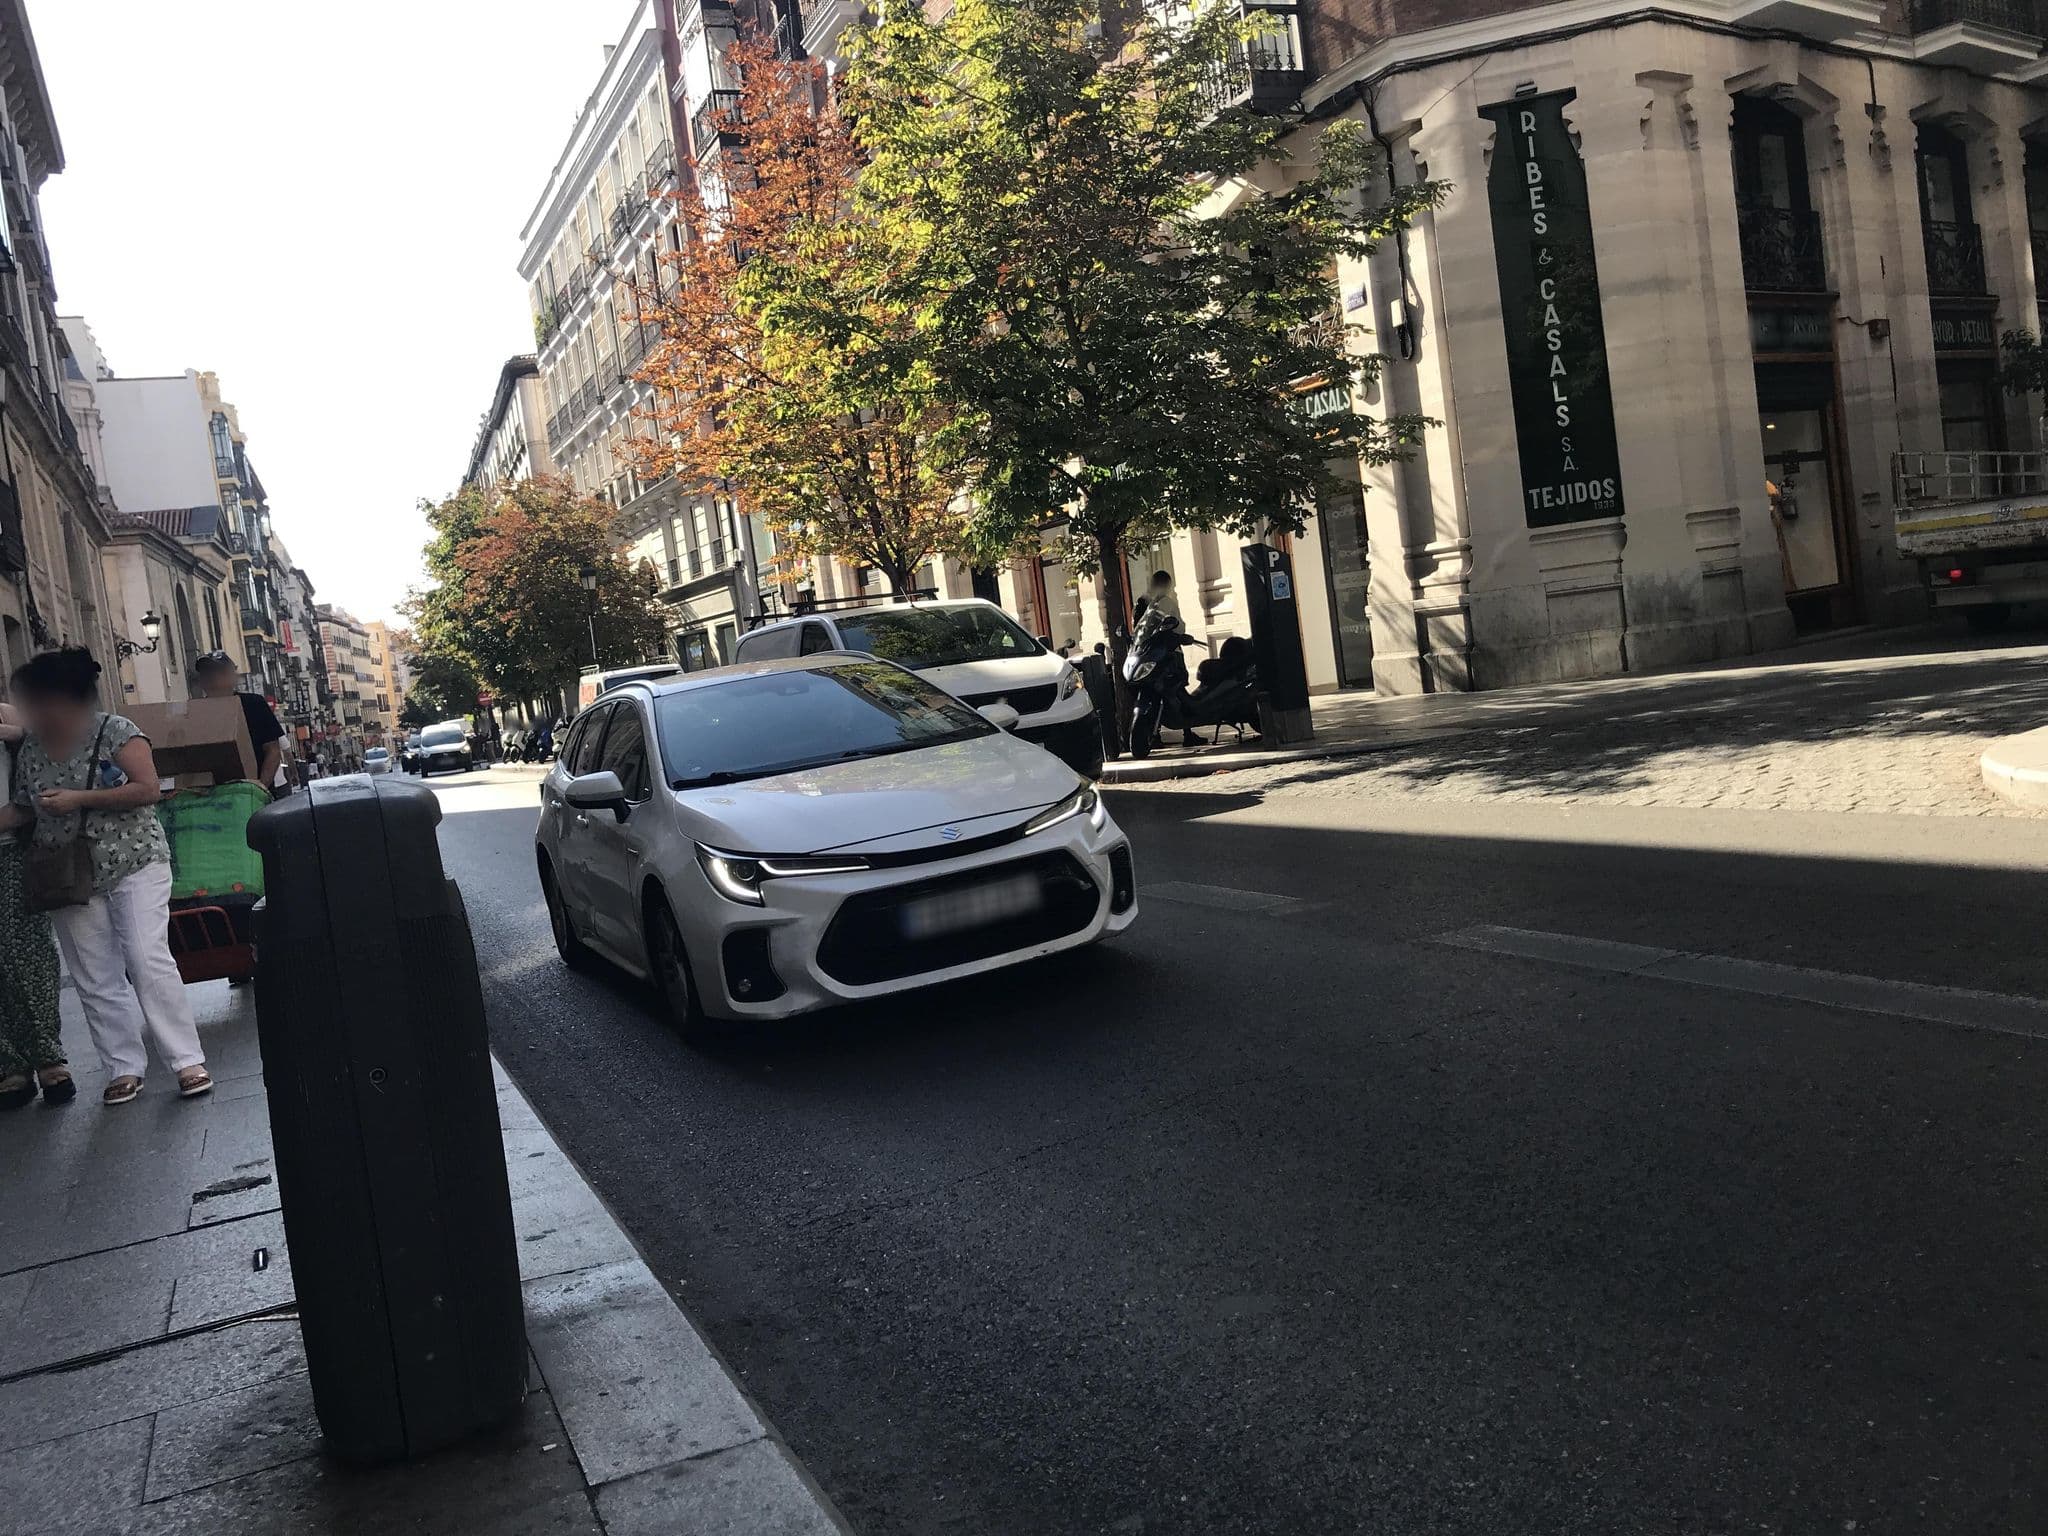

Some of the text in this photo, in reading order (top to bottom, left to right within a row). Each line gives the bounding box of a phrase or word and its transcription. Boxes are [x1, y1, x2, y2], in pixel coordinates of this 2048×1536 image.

[1520, 110, 1548, 235] RIBES
[1538, 248, 1554, 265] &
[1933, 319, 1955, 343] AYOR
[1540, 278, 1570, 428] CASALS
[1528, 477, 1616, 510] TEJIDOS
[1268, 551, 1280, 568] P
